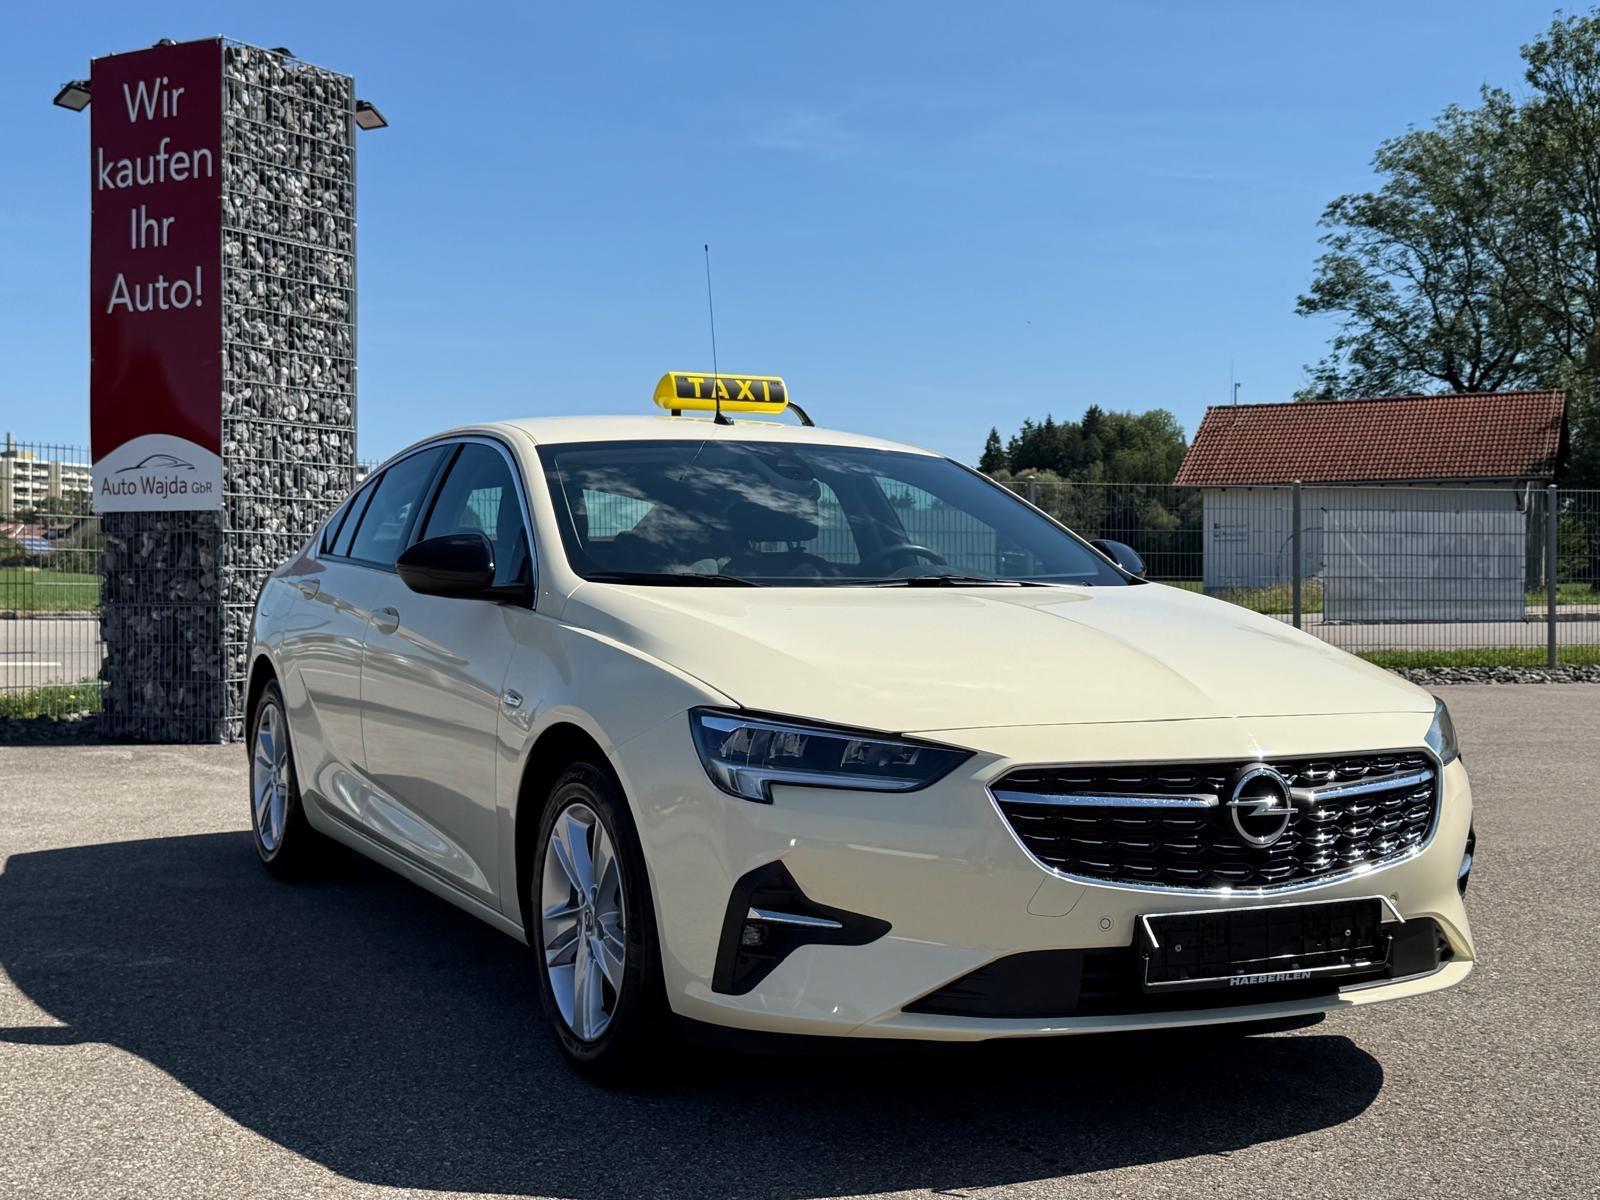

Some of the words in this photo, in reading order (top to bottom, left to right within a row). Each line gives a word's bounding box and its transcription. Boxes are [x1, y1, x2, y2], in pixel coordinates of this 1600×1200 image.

[123, 76, 185, 123] Wir
[98, 137, 213, 191] kaufen
[131, 204, 176, 250] Ihr
[106, 265, 203, 314] Auto!
[687, 377, 771, 402] TAXI
[101, 477, 137, 496] Auto
[140, 475, 188, 499] Wajda
[191, 481, 213, 494] GbR
[1229, 971, 1312, 986] HAEBERLEN
